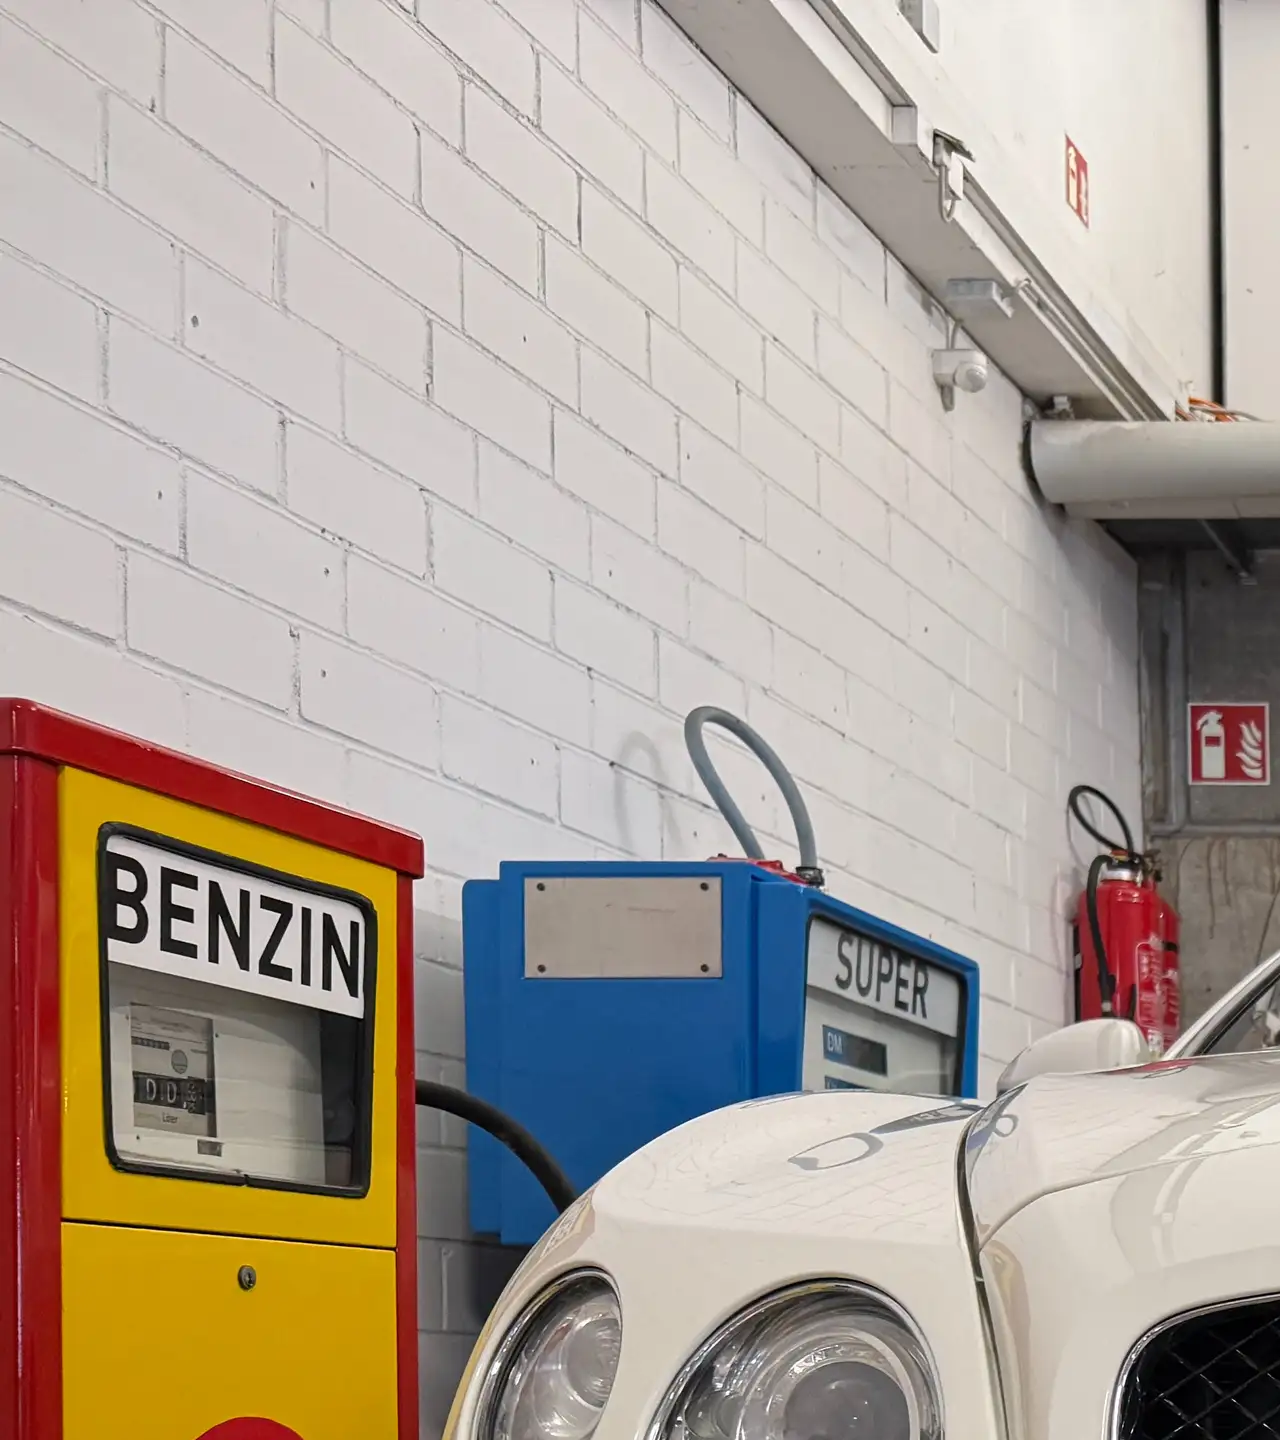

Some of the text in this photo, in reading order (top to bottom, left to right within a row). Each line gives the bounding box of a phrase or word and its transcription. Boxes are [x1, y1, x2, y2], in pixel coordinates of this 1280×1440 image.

[107, 851, 360, 999] BENZIN
[835, 932, 928, 1019] SUPER
[826, 1031, 843, 1054] DM
